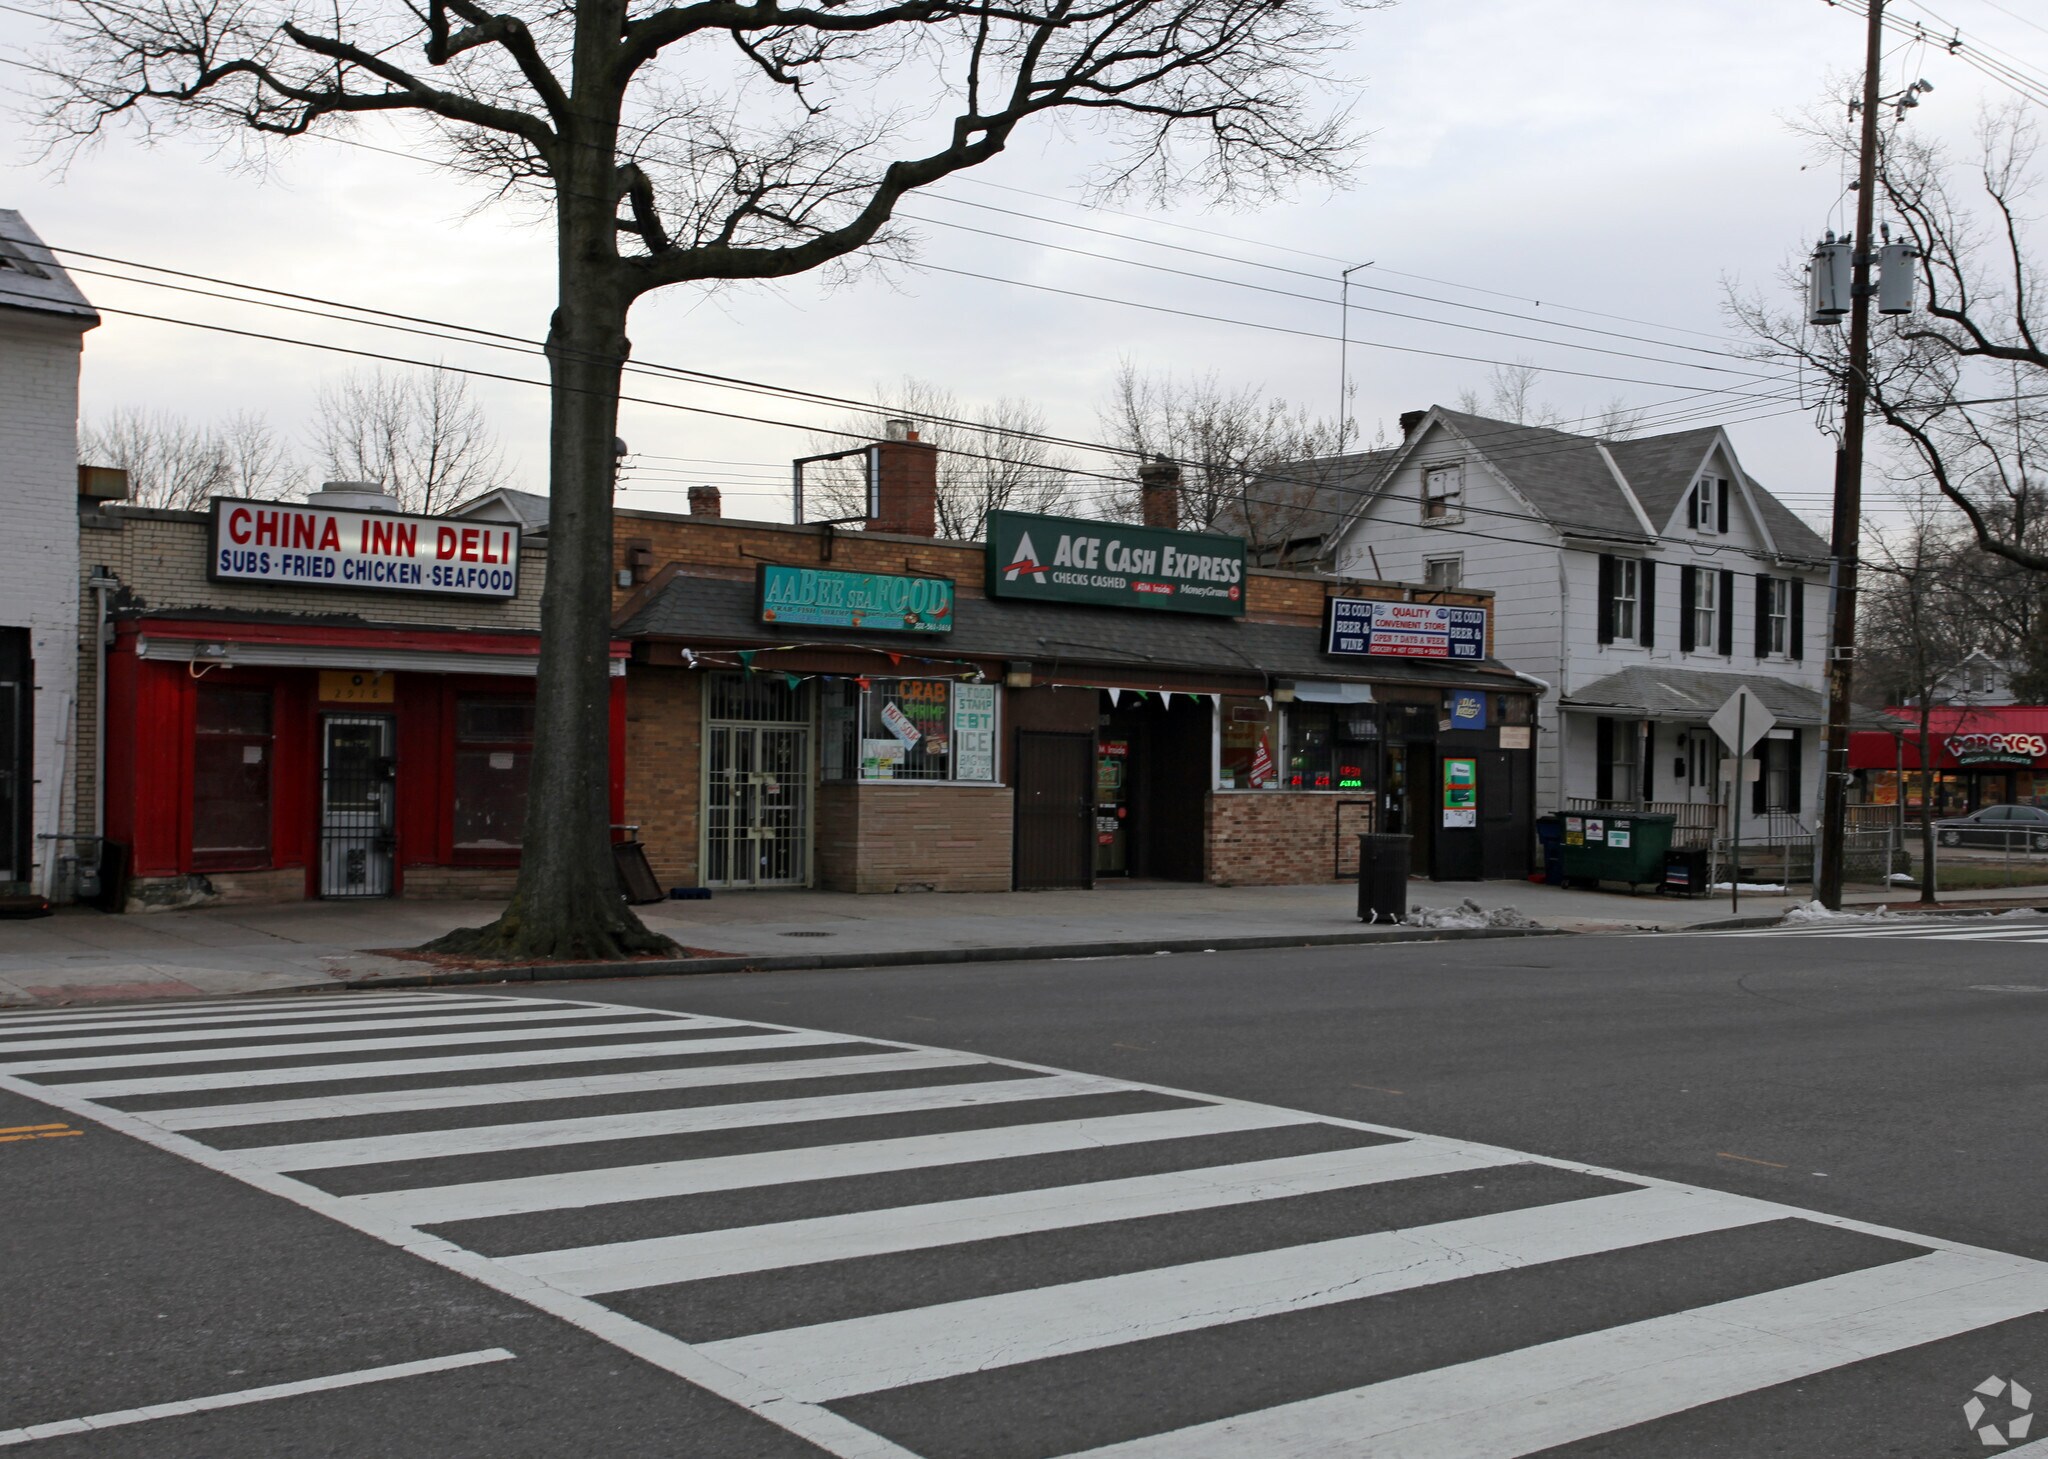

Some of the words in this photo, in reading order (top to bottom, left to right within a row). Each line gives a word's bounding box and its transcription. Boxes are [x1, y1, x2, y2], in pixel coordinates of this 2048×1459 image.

[228, 507, 341, 552] CHINA
[360, 519, 418, 558] INN
[436, 526, 510, 565] DELI
[1053, 535, 1101, 569] ACE
[220, 549, 270, 574] SUBS
[282, 554, 335, 578] FRIED
[343, 558, 421, 584] CHICKEN
[432, 565, 513, 590] SEAFOOD
[1052, 572, 1089, 586] CHECKS
[1091, 575, 1126, 589] CASHED
[1180, 584, 1229, 598] MoneyGram
[1337, 604, 1350, 616] ICE
[1351, 604, 1371, 617] COLD
[1392, 607, 1430, 618] QUALITY
[1451, 611, 1462, 622] ICE
[1464, 612, 1482, 624] COLD
[1336, 621, 1361, 634] BEER
[1362, 622, 1370, 634] &
[1375, 619, 1421, 630] CONVENIENT
[1424, 622, 1446, 630] STORE
[1374, 634, 1392, 642] OPEN
[1400, 636, 1418, 644] DAYS
[1426, 637, 1446, 645] WEEK
[1451, 627, 1473, 639] BEER
[1474, 628, 1481, 640] &
[1340, 638, 1363, 650] WINE
[1371, 645, 1393, 653] GROCERY
[1407, 647, 1424, 655] COFFEE
[1429, 648, 1448, 656] SNACKS
[1454, 644, 1476, 655] WINE
[899, 681, 945, 703] CRAB
[967, 687, 992, 699] FOOD
[960, 699, 992, 709] STAMP
[903, 704, 945, 720] SHRIMP
[885, 705, 902, 723] HOT
[901, 722, 920, 741] SOUP
[956, 712, 991, 728] EBT
[960, 732, 989, 751] ICE
[1339, 779, 1361, 787] ATM
